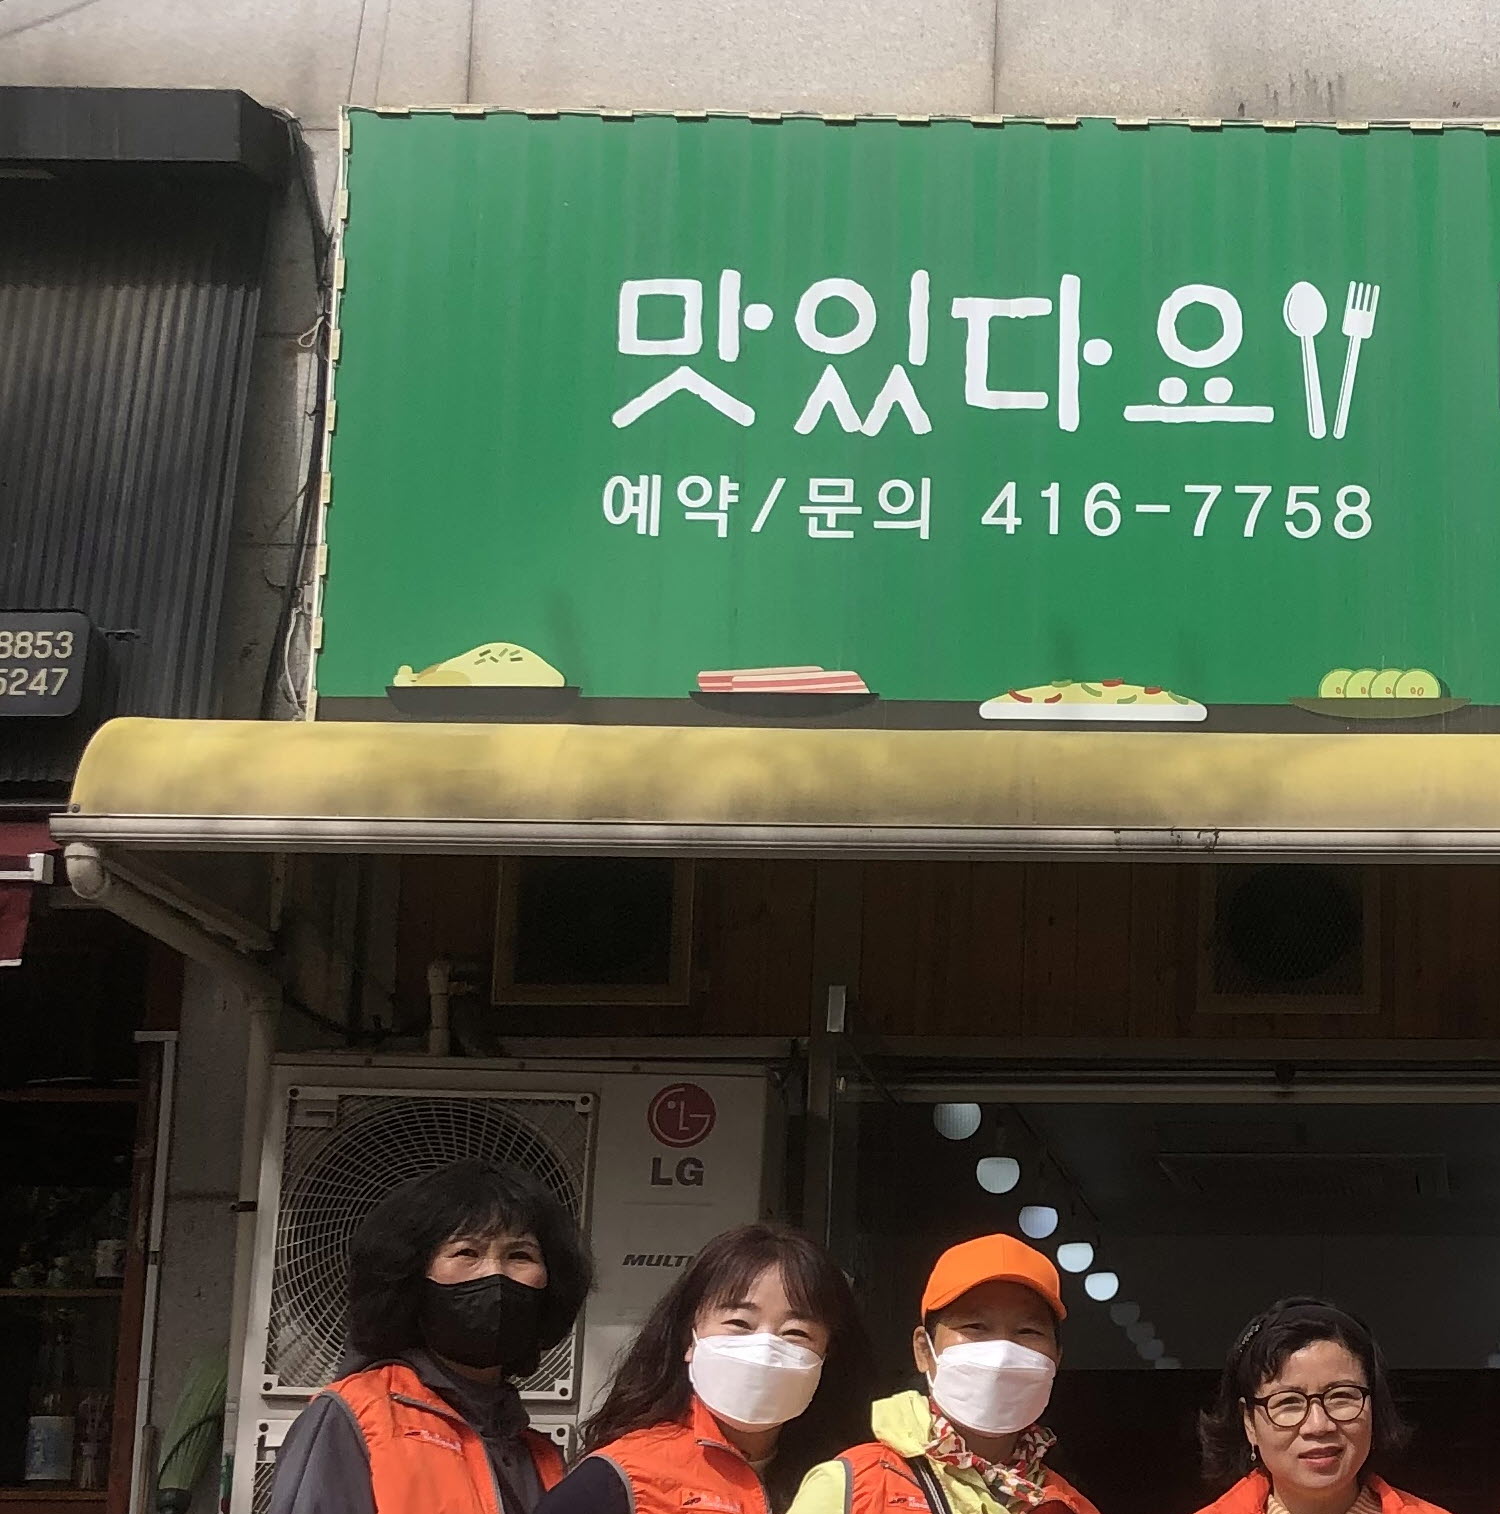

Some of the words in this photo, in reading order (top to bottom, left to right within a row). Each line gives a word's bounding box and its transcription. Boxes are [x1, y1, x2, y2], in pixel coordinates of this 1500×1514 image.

[611, 269, 1274, 436] 맛있다요
[602, 474, 931, 540] 예약/문의
[981, 482, 1373, 540] 416-7758
[651, 1157, 704, 1186] LG
